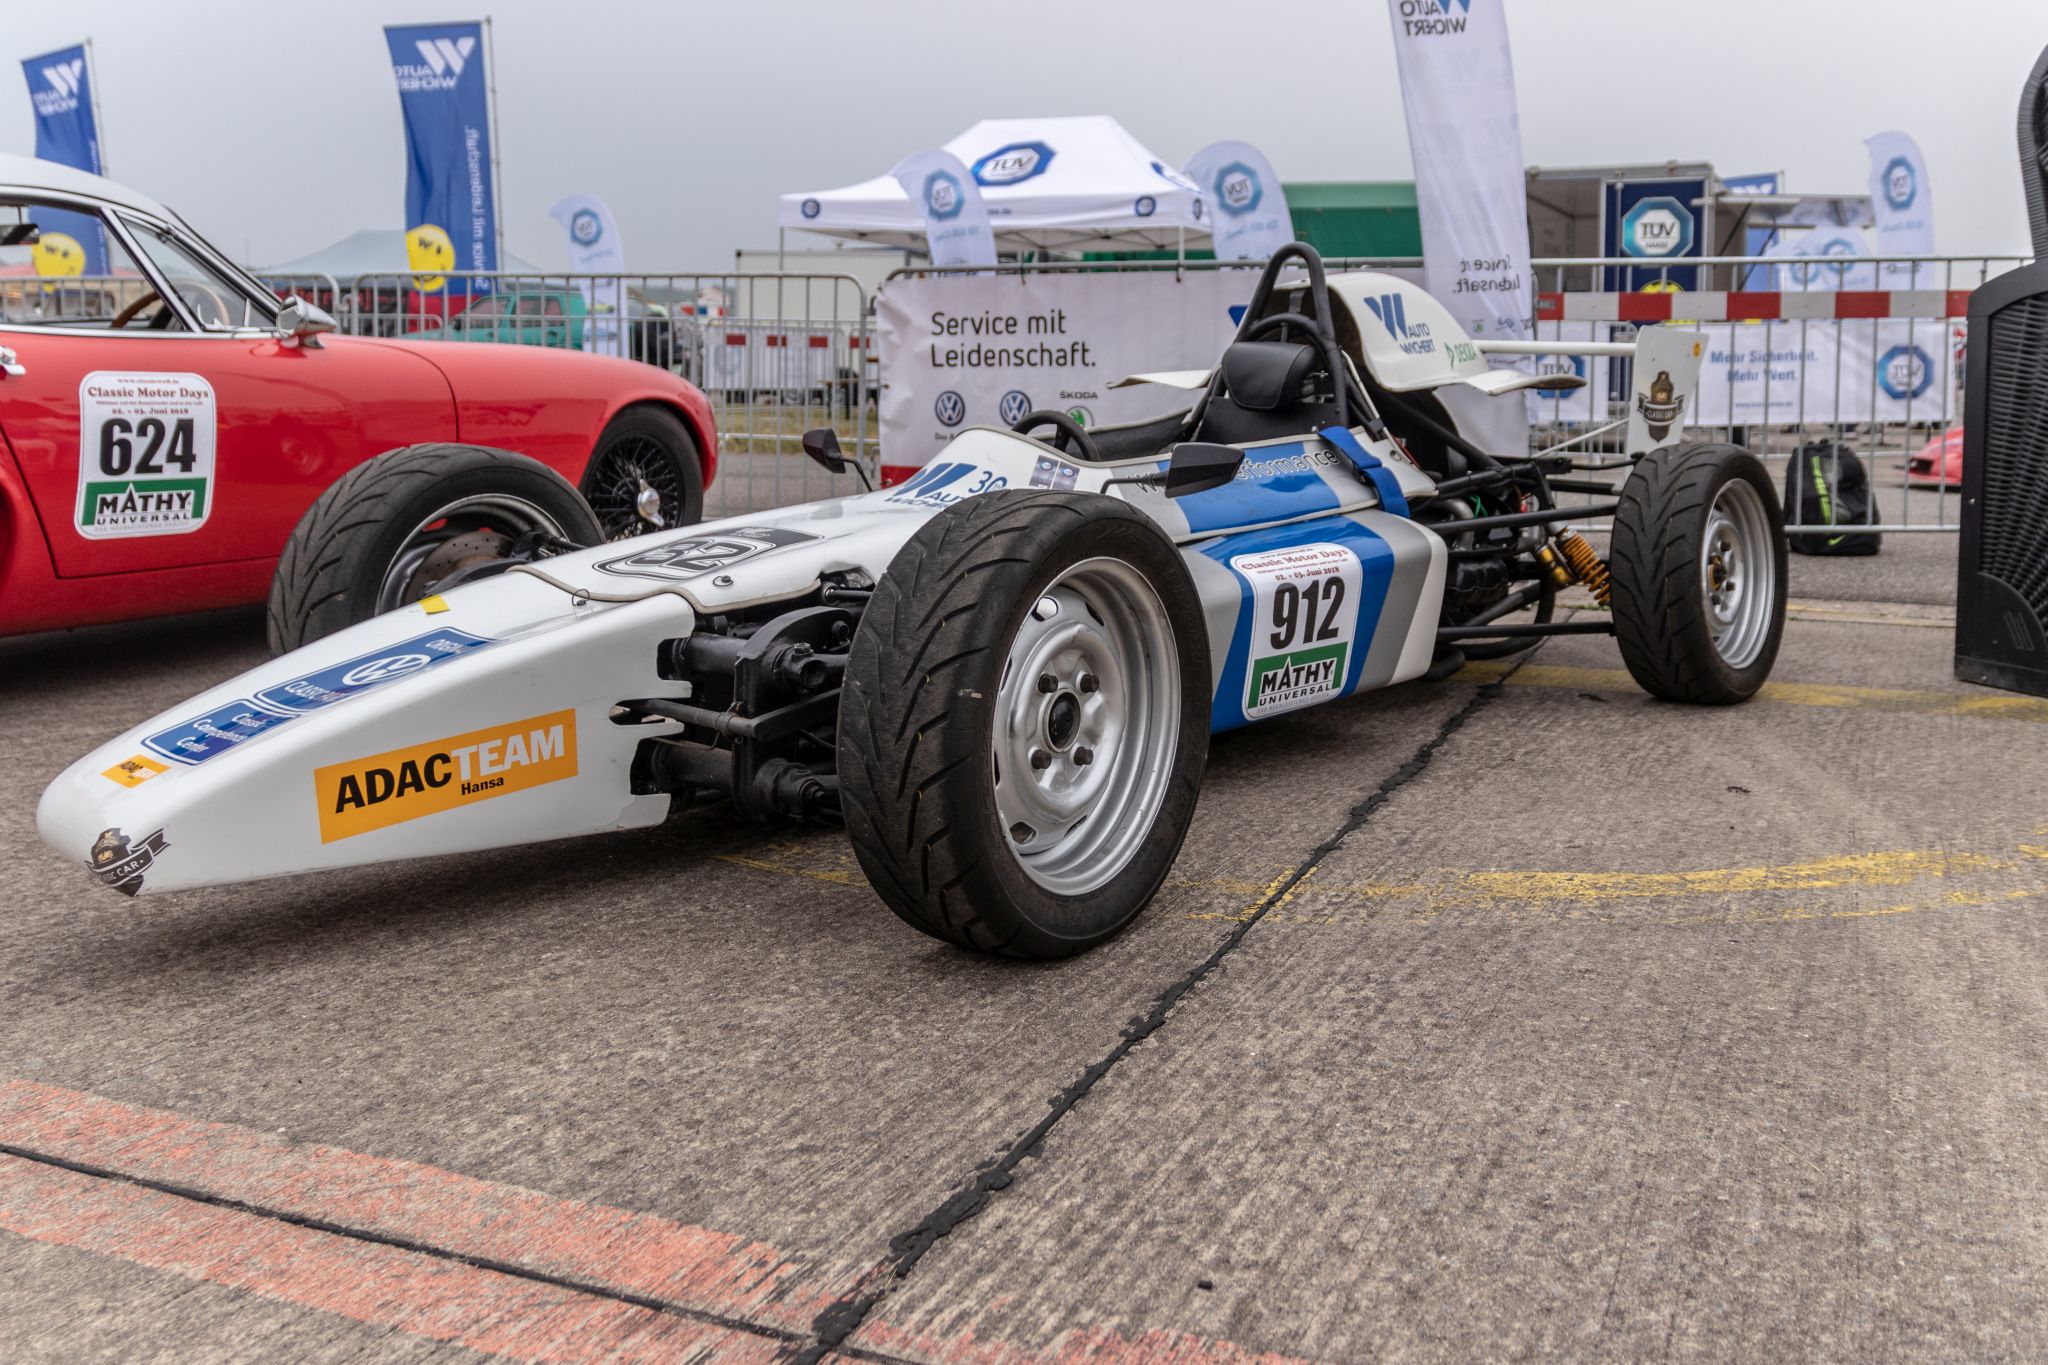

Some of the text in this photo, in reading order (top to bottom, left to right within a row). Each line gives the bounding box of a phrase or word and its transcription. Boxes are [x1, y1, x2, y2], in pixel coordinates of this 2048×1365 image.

[931, 309, 1067, 336] Service mit
[1408, 322, 1431, 338] AUTO
[931, 341, 1096, 368] Leidenschaft.
[1400, 339, 1436, 355] WICHERT
[88, 387, 209, 399] Classic Motor Days
[1060, 390, 1098, 399] ŠKODA
[149, 407, 168, 415] Juni
[99, 418, 196, 476] 624
[98, 488, 192, 514] MATHY
[97, 513, 190, 525] UNIVERSAL
[626, 538, 757, 572] 32
[1242, 559, 1282, 570] Classic
[1284, 553, 1319, 565] Motor
[1321, 549, 1349, 559] Days
[1306, 568, 1322, 577] Juni
[1323, 566, 1340, 575] 2018
[1271, 577, 1345, 650] 912
[1261, 660, 1335, 694] MATHY
[1260, 683, 1331, 706] UNIVERSAL
[461, 777, 504, 796] Hansa
[116, 860, 139, 876] CAR
